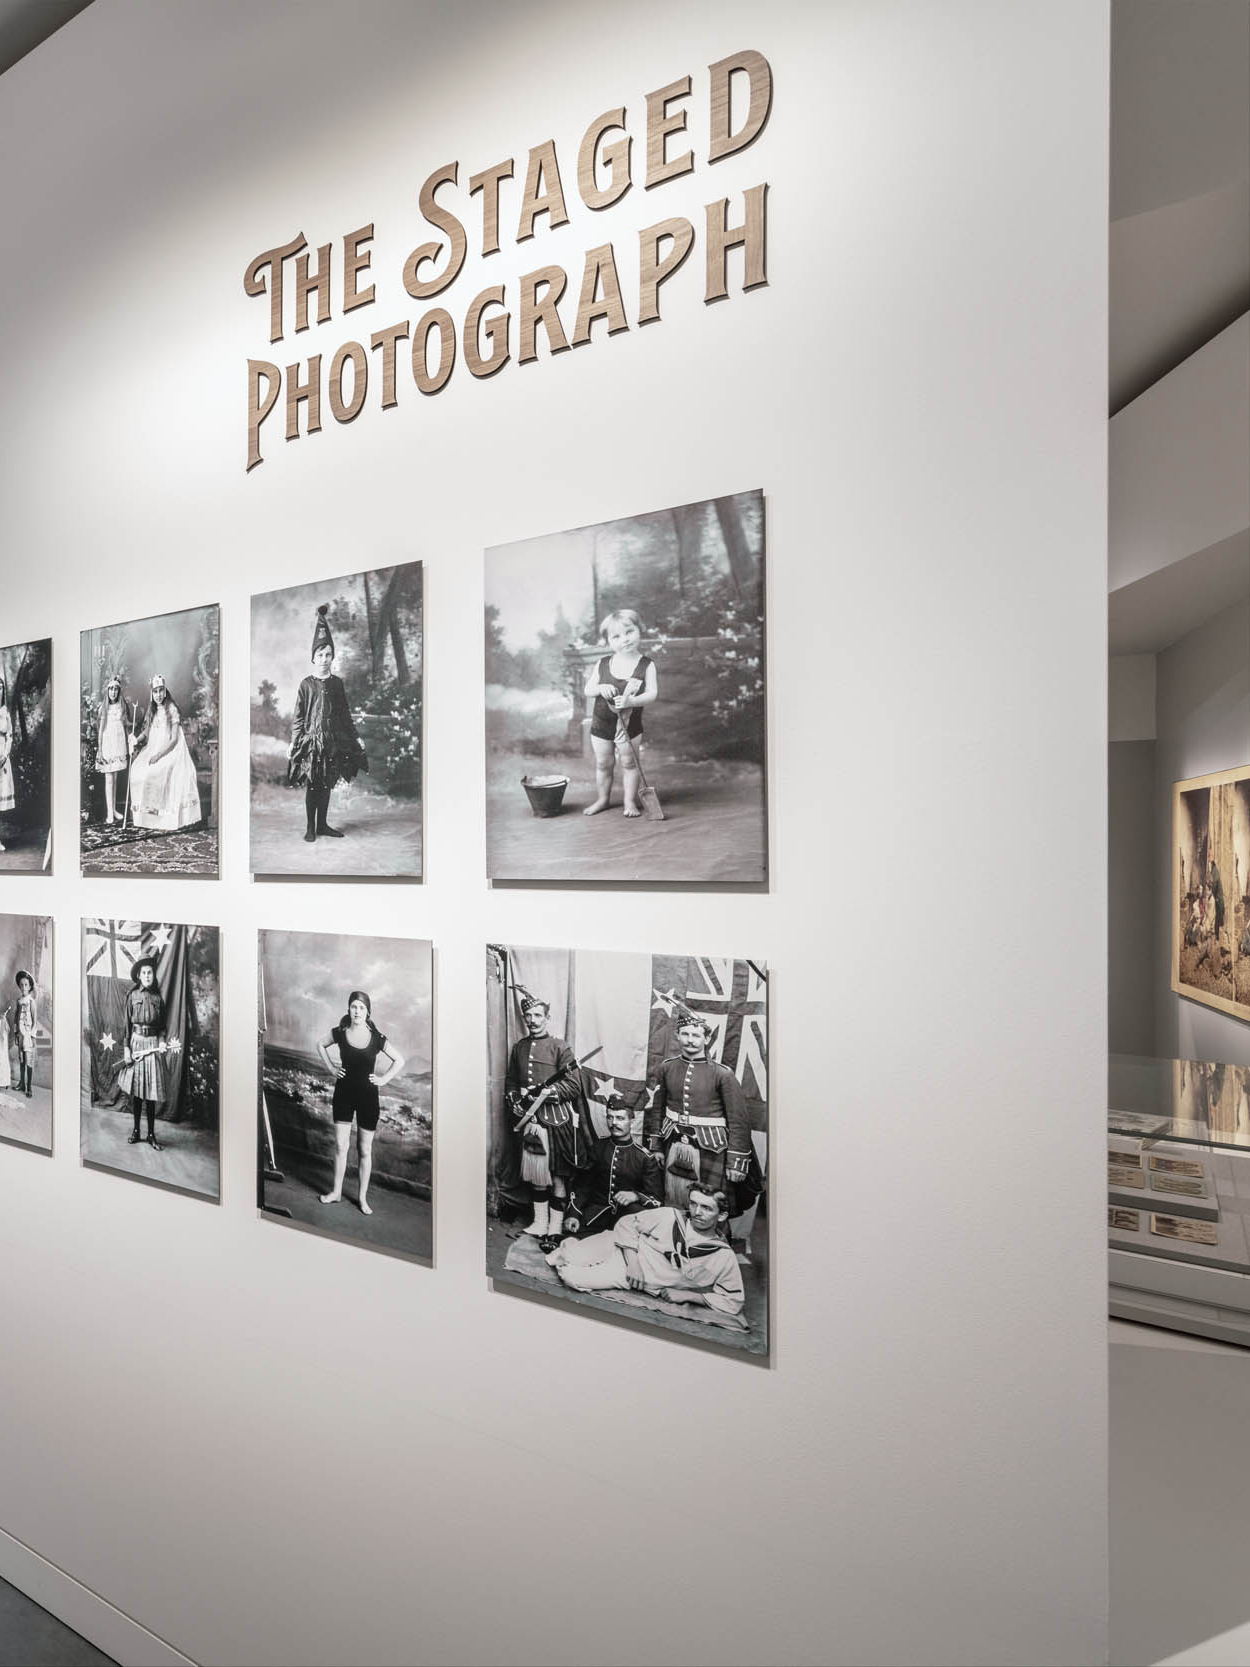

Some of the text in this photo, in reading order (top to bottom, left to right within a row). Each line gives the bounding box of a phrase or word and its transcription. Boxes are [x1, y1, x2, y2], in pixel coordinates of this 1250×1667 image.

[244, 50, 774, 343] THE STAGED
[246, 182, 770, 474] PHOTOGRAPH
